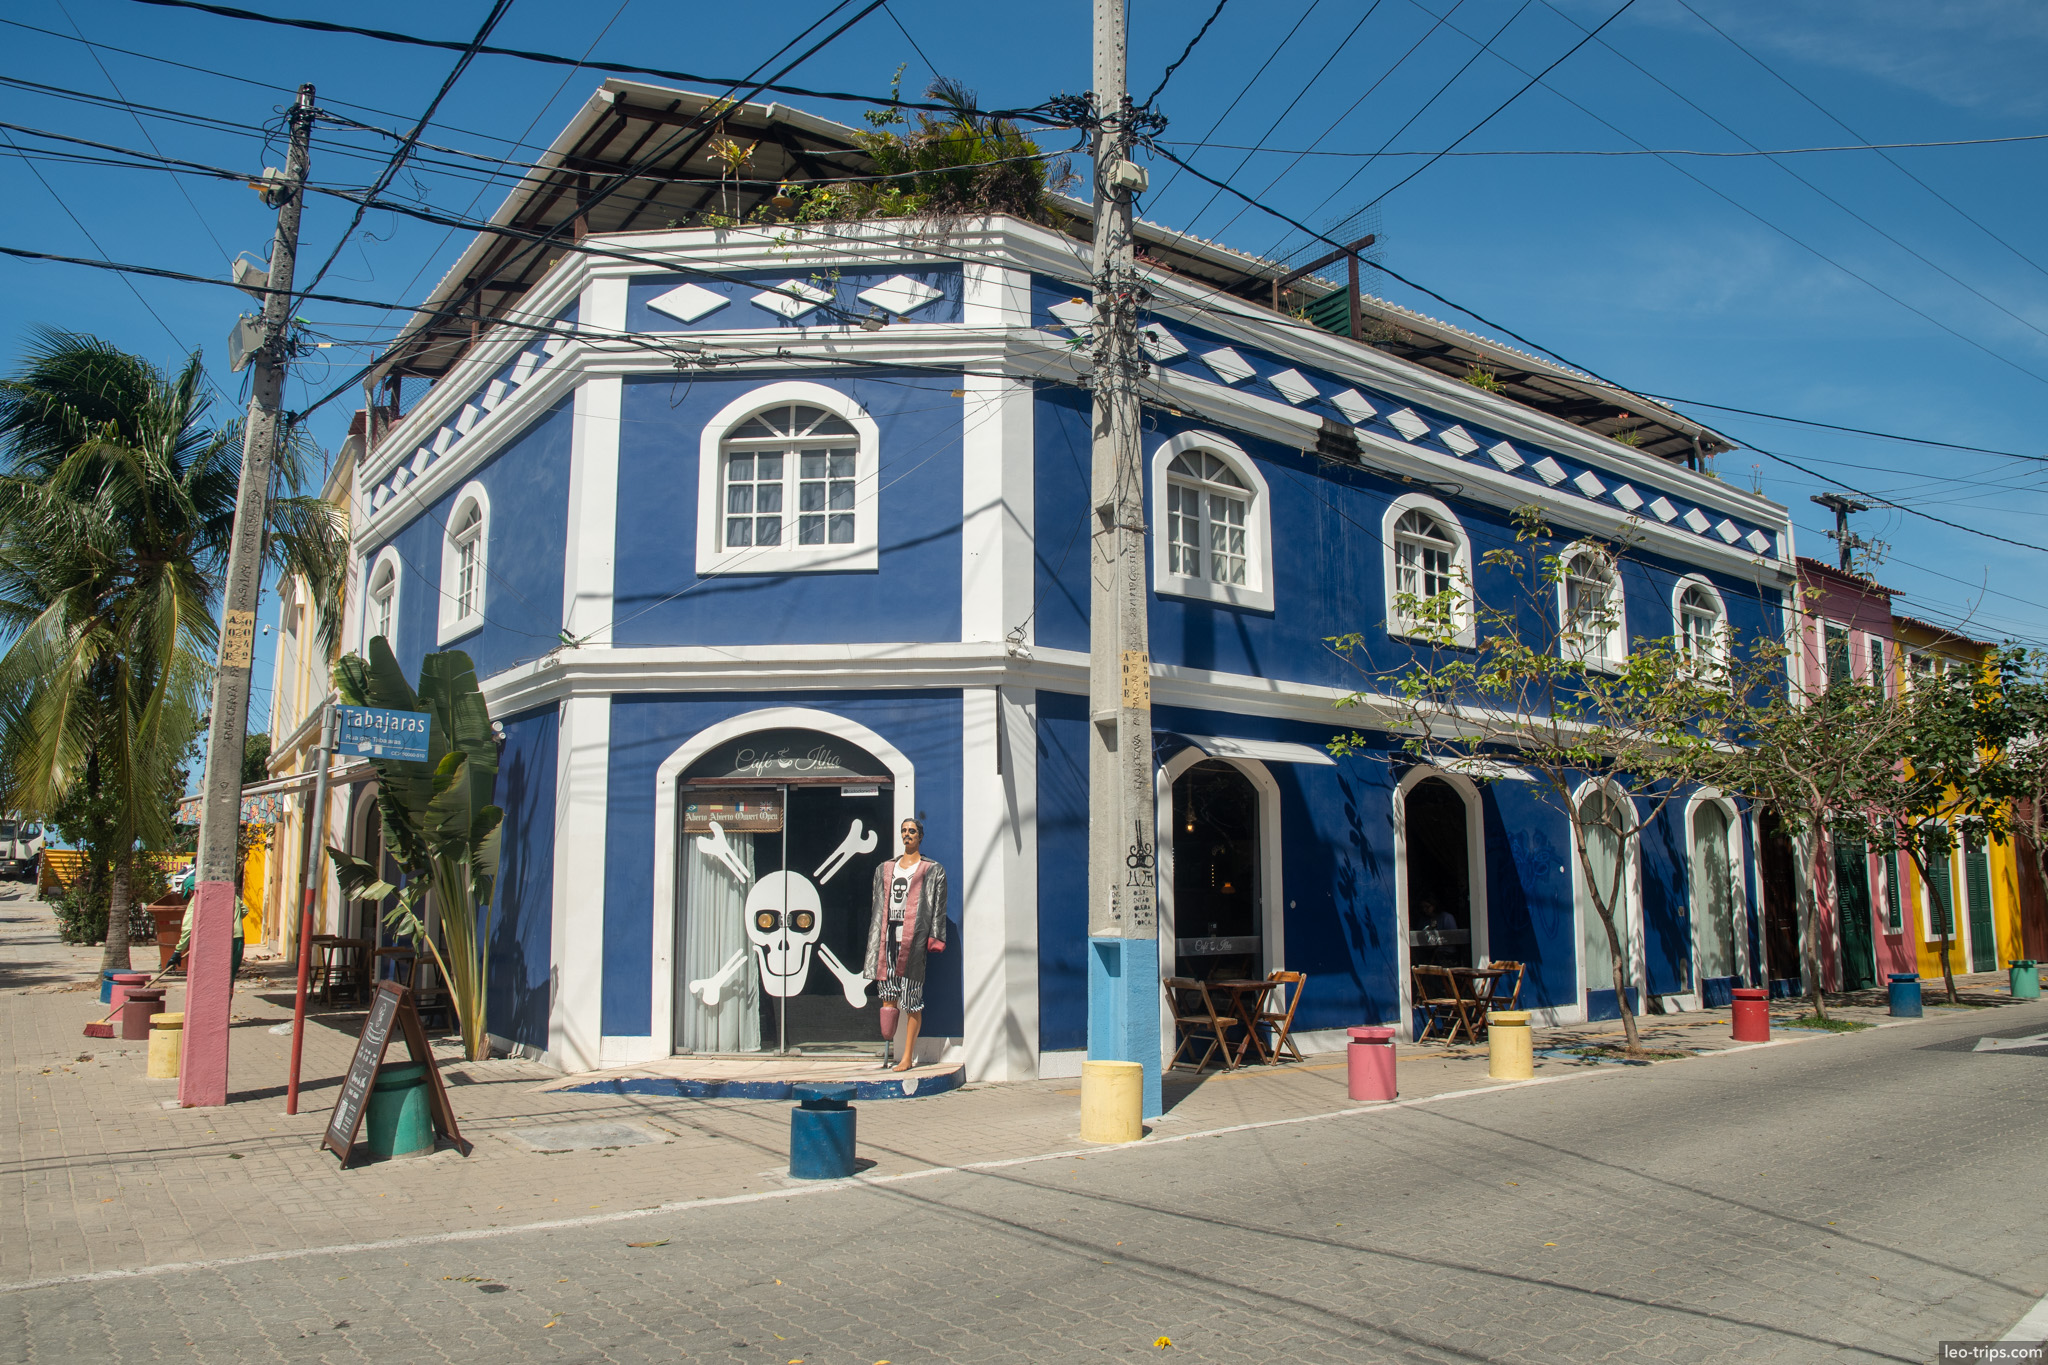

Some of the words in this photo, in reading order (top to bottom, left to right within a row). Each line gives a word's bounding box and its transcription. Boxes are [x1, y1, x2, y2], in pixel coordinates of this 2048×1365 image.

[346, 710, 425, 734] Tabajaras
[735, 748, 774, 776] Café
[795, 745, 841, 771] Ilha
[685, 812, 708, 821] Aberto
[709, 812, 734, 821] Abierto
[759, 811, 778, 822] Open
